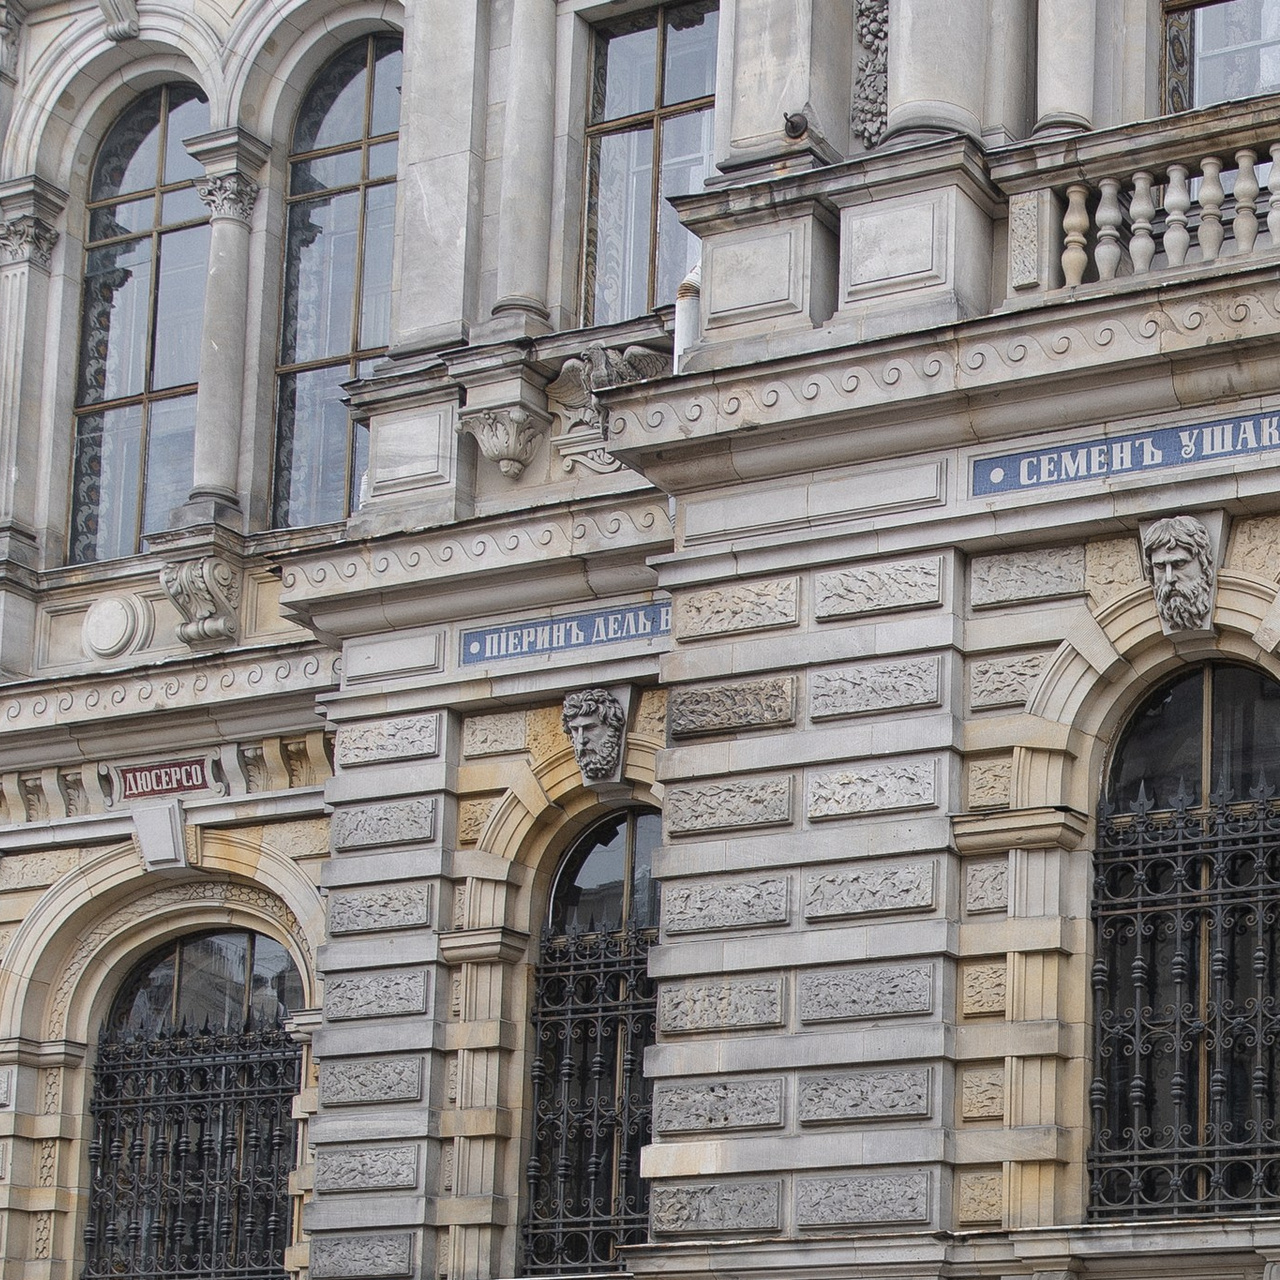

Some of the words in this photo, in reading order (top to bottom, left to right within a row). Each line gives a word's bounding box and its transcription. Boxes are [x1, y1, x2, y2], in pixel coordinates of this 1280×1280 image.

[1019, 437, 1163, 485] СЕМЕНЪ
[592, 610, 651, 642] ДЕЛЬ
[125, 764, 203, 795] ДЮСЕРСО
